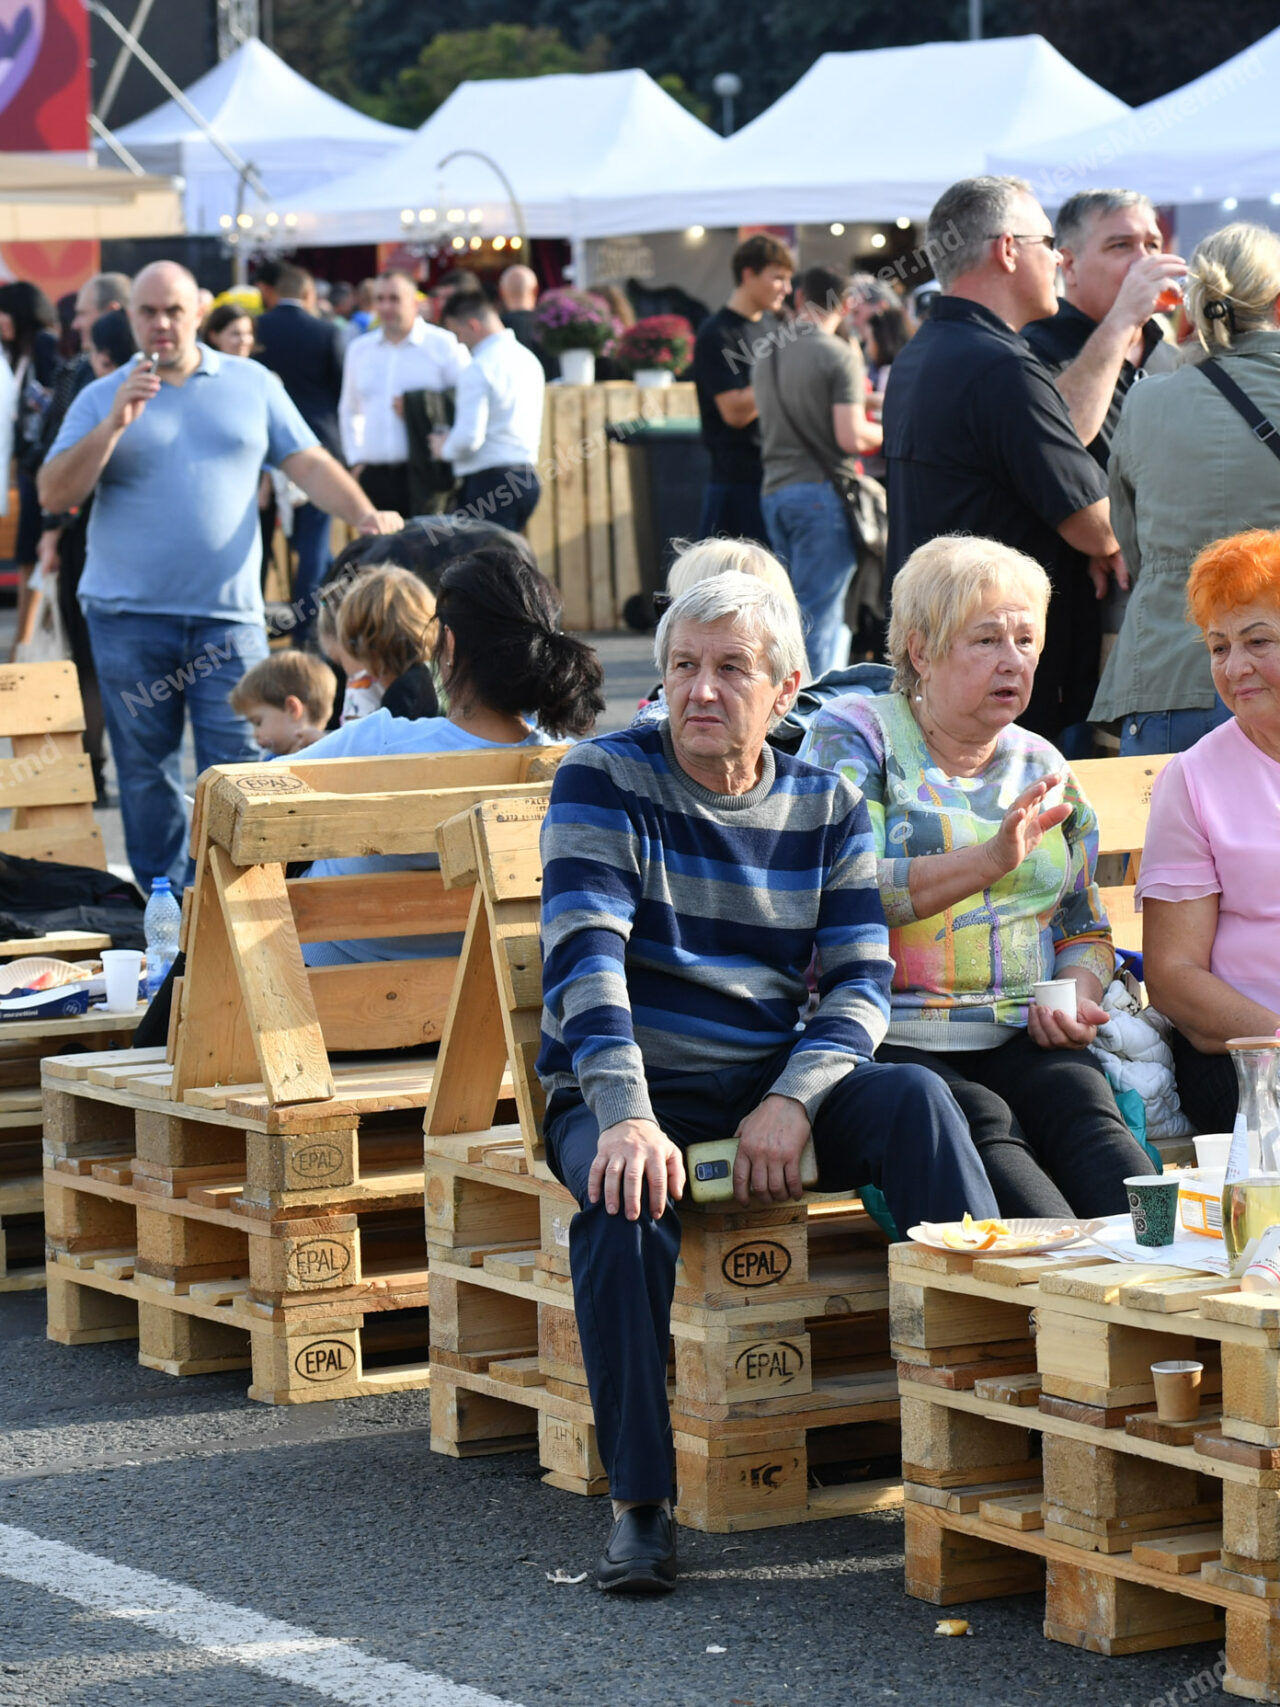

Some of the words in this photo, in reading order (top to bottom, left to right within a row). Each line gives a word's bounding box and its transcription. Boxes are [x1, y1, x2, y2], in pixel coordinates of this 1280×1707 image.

[245, 778, 290, 789] EPAL
[300, 1150, 337, 1170] EPAL
[297, 1248, 340, 1275] EPAL
[733, 1249, 782, 1279] EPAL
[305, 1348, 347, 1374] EPAL
[746, 1351, 793, 1380] EPAL
